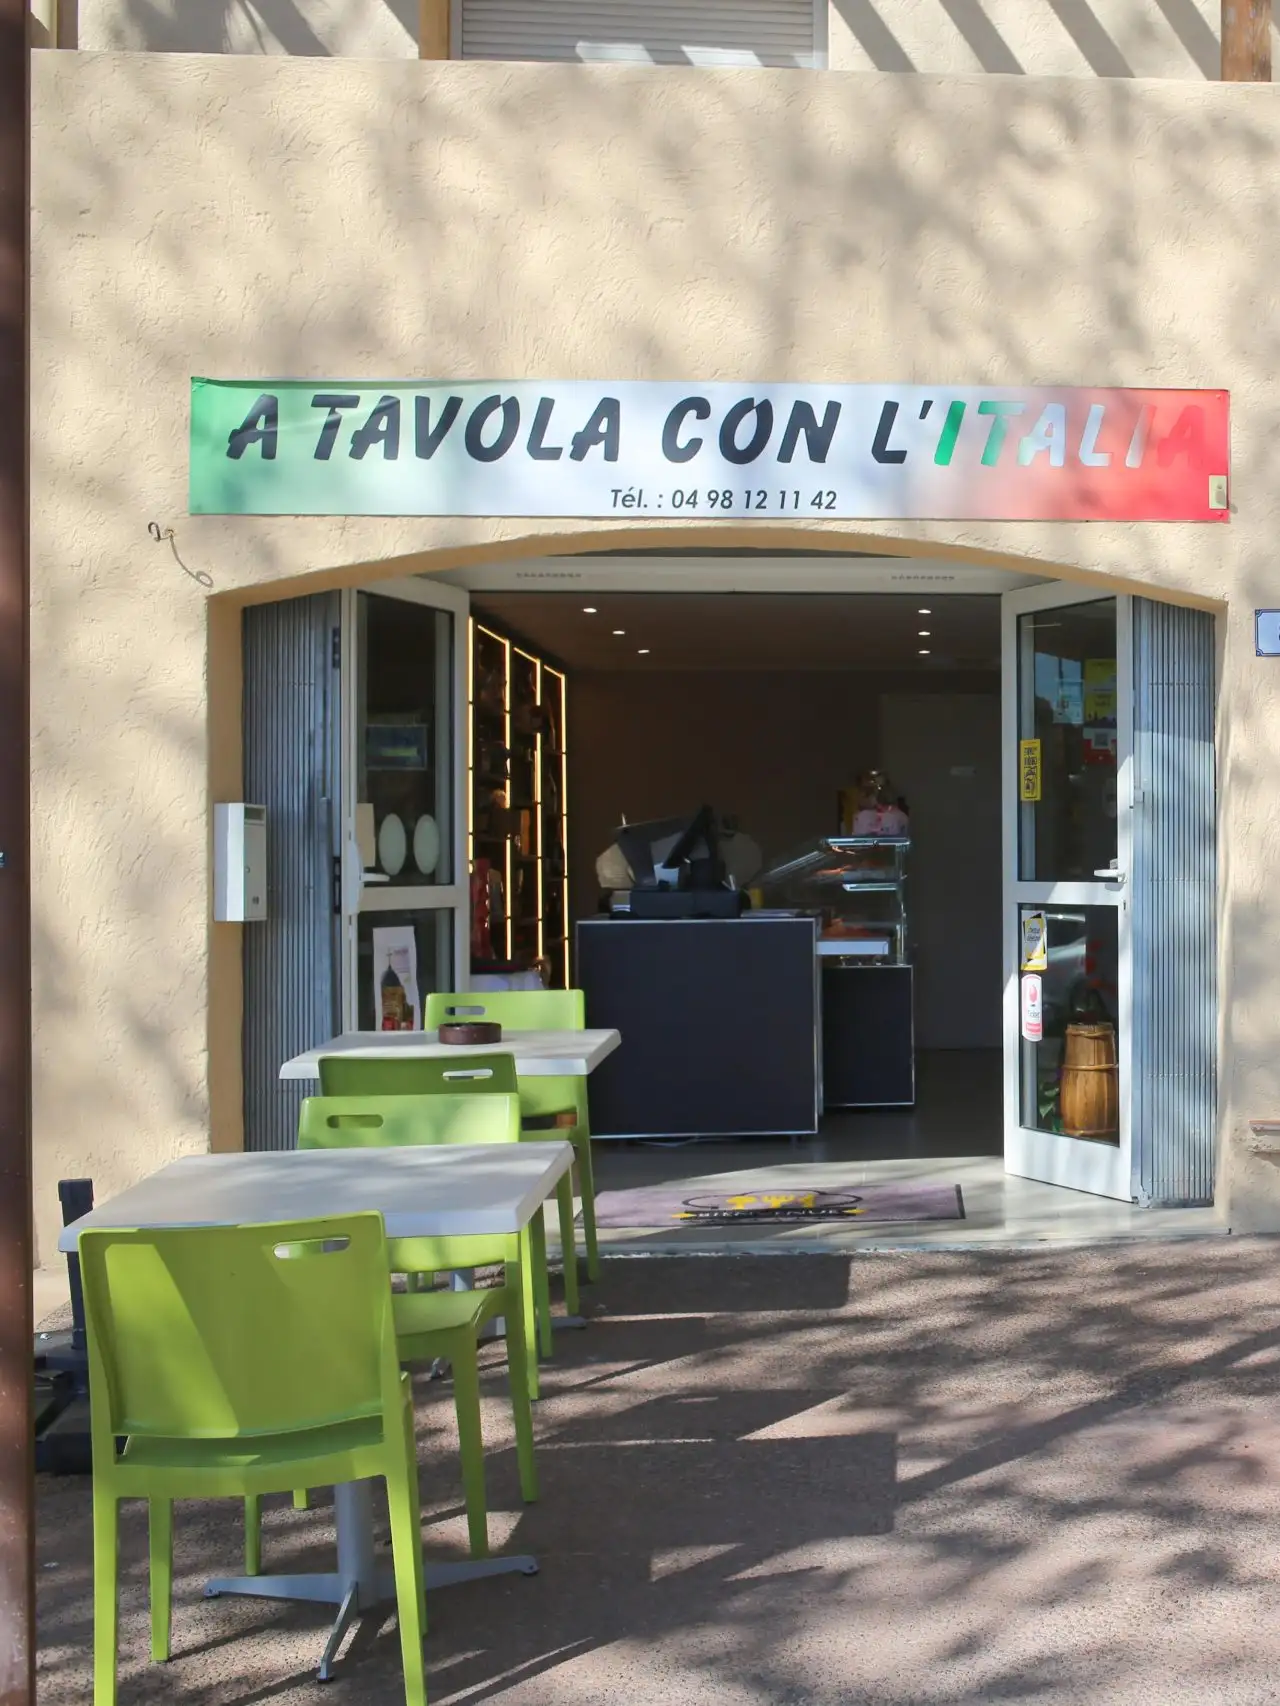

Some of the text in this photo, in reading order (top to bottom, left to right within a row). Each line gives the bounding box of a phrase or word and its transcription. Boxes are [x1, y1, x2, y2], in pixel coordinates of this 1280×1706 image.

[226, 394, 279, 460] A
[311, 393, 621, 463] TAVOLA
[662, 396, 842, 466] CON
[671, 489, 699, 510] 04
[706, 489, 734, 510] 98
[744, 489, 768, 510] 12
[779, 490, 801, 510] 11
[810, 490, 838, 511] 42
